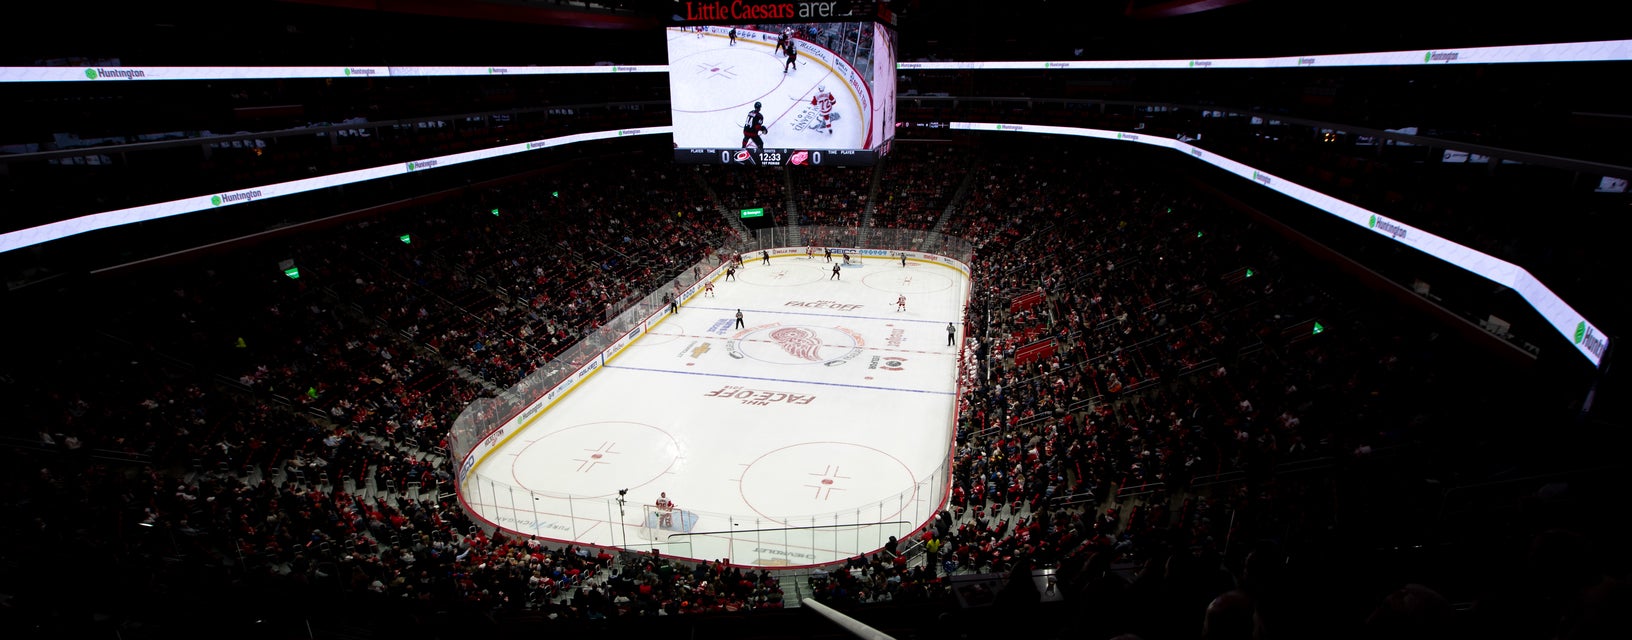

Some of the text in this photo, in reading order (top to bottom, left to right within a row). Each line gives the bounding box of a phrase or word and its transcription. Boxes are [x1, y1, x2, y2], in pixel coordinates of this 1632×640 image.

[686, 1, 729, 20] Little
[731, 0, 795, 19] Caesars
[97, 67, 145, 80] Huntington
[819, 98, 832, 110] 72
[722, 150, 730, 164] 0
[759, 153, 781, 161] 12:33
[812, 151, 821, 165] 0
[221, 190, 262, 204] Huntington
[1376, 216, 1408, 239] Huntington
